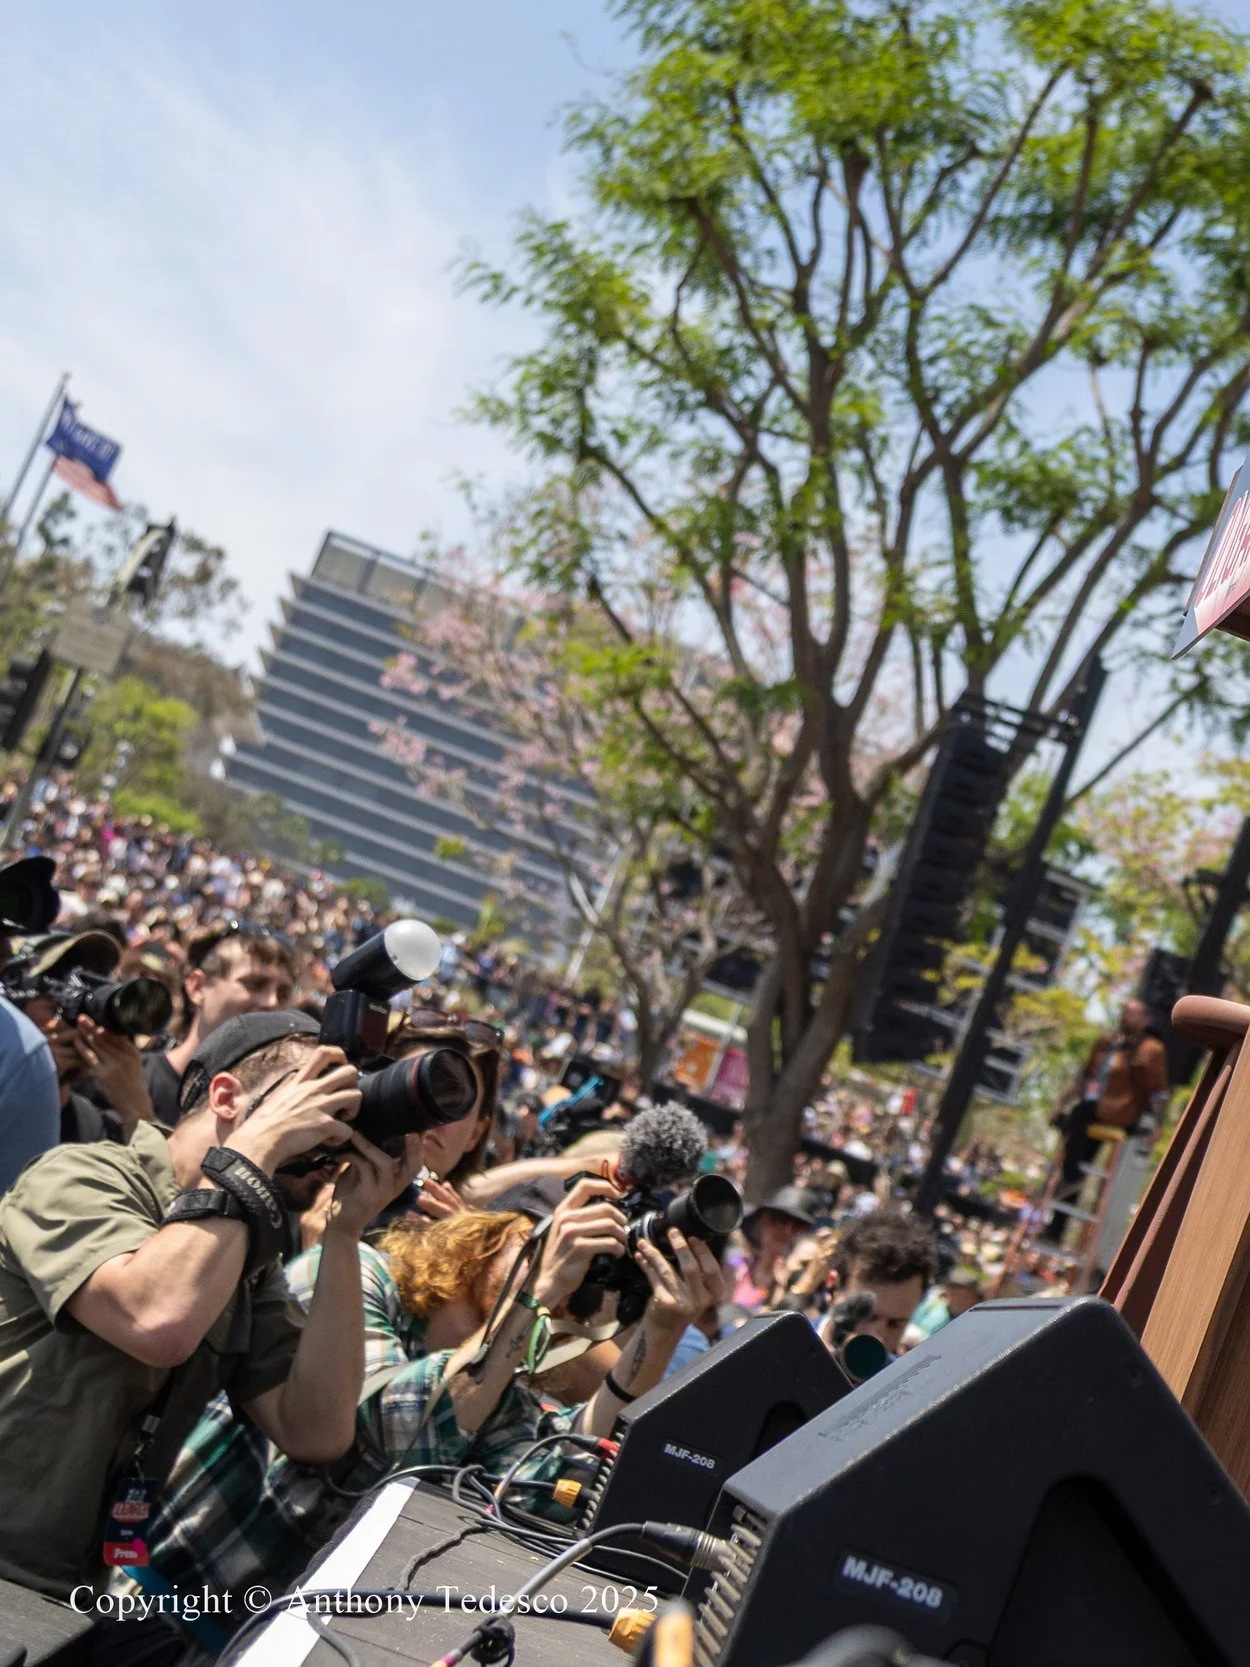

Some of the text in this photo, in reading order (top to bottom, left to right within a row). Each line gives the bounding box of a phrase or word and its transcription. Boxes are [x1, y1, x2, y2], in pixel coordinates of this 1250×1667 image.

[234, 1167, 282, 1229] Canon
[664, 1443, 716, 1469] MJF-208
[843, 1555, 943, 1608] MJF-208
